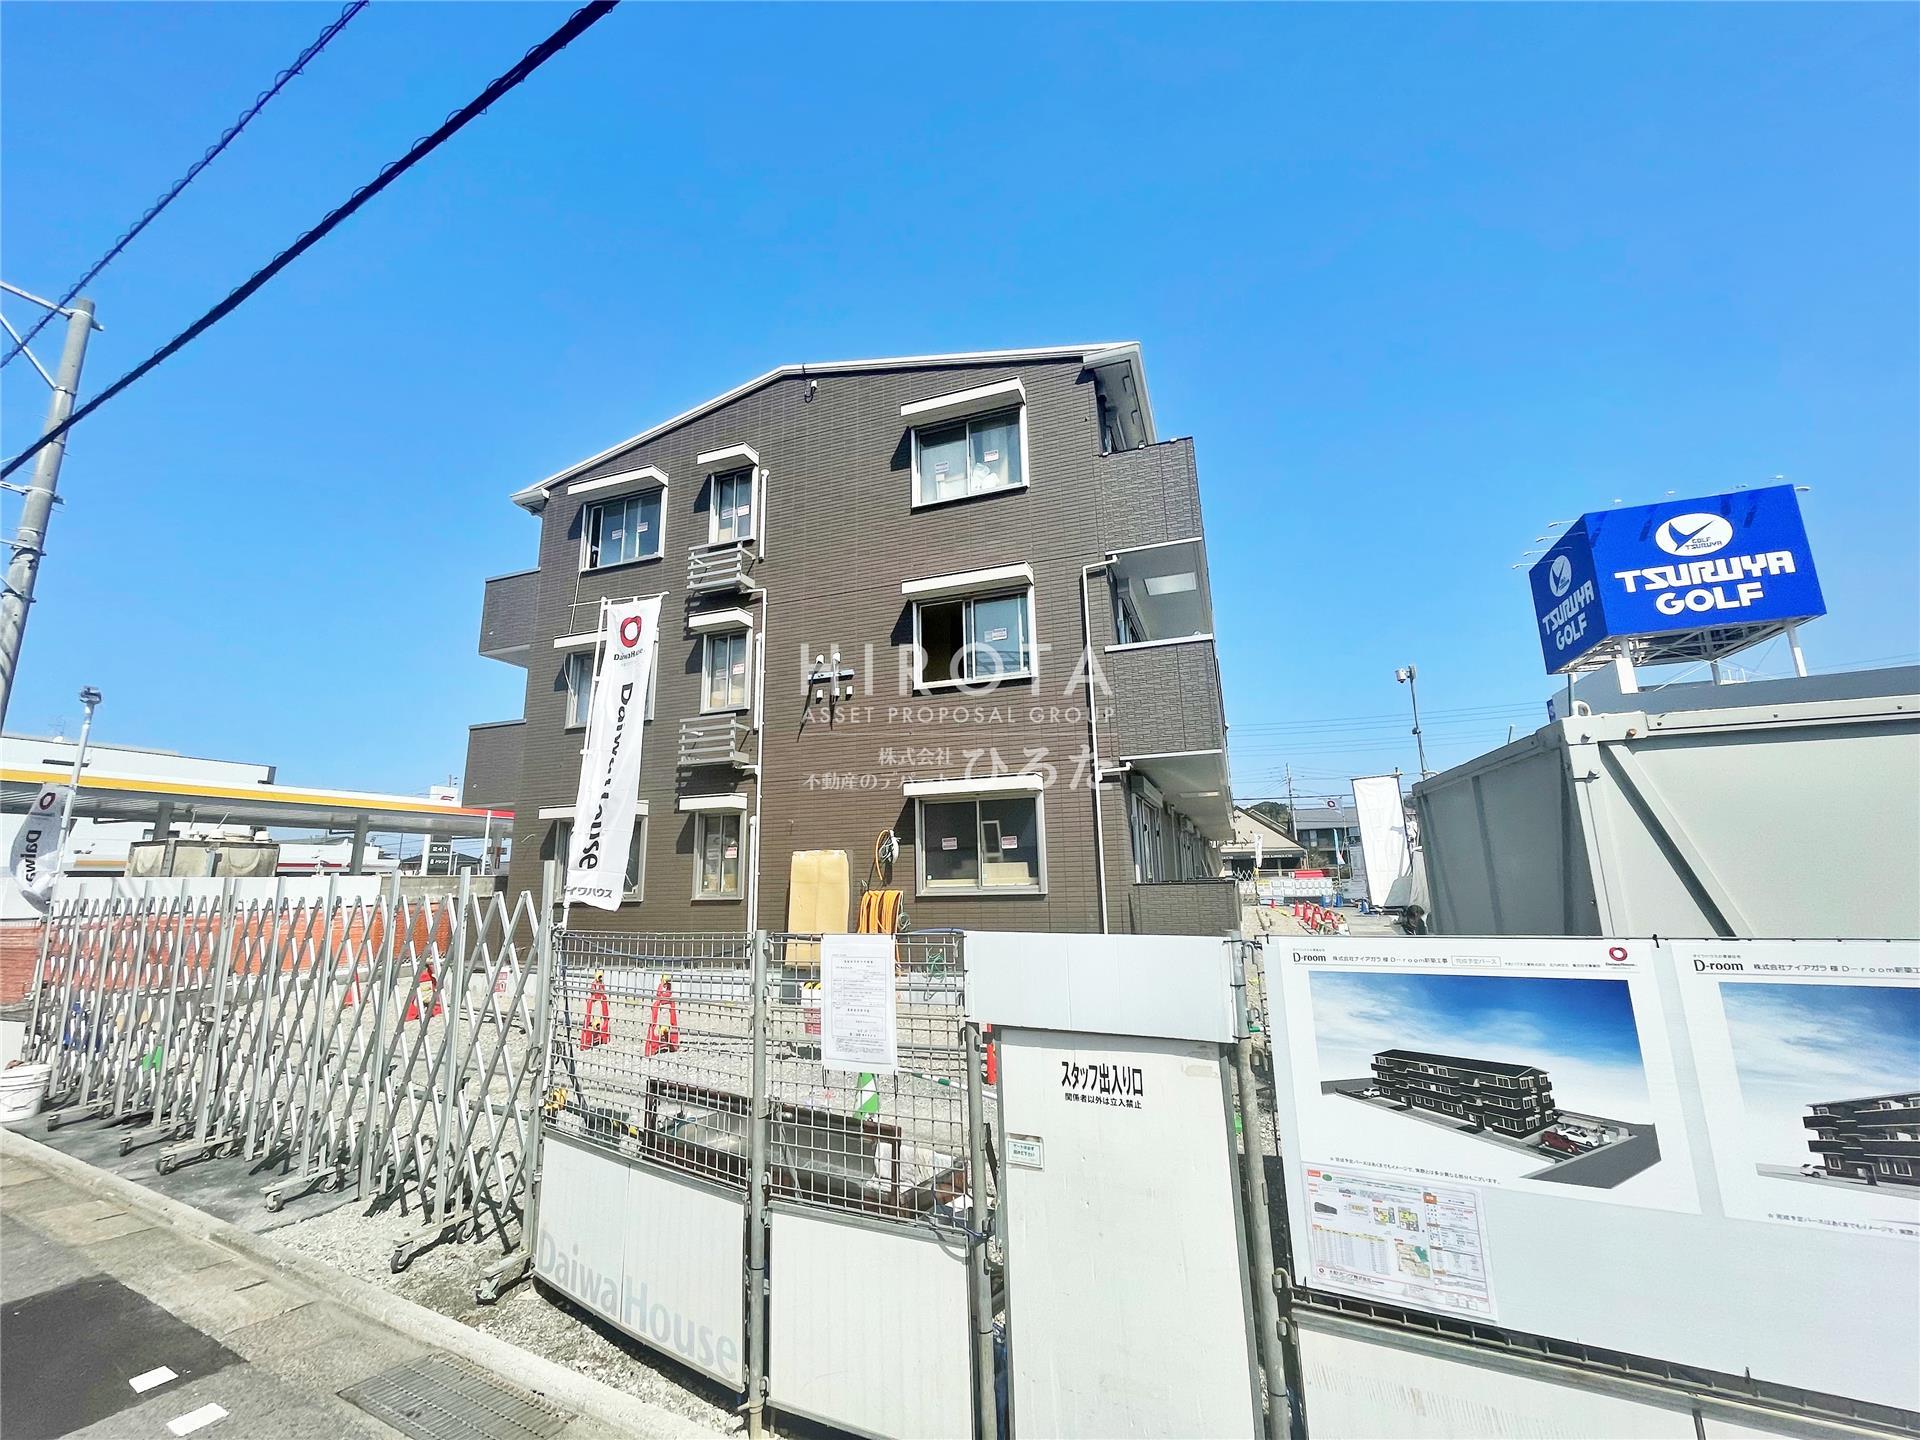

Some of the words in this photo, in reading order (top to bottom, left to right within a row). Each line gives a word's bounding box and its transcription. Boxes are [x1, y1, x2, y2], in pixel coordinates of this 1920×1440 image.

[1614, 550, 1797, 593] TSURUYA
[1542, 580, 1595, 636] TSURUYA
[1655, 582, 1764, 616] GOLF
[1555, 615, 1588, 651] GOLF
[565, 886, 613, 899] イワハウス
[1292, 952, 1327, 963] D-room
[1694, 959, 1744, 972] D-room
[1061, 1061, 1144, 1097] スタッフ出入り口
[1064, 1092, 1142, 1109] 関係者以外は立入禁止
[537, 1230, 619, 1317] Daiwa
[623, 1274, 739, 1378] House
